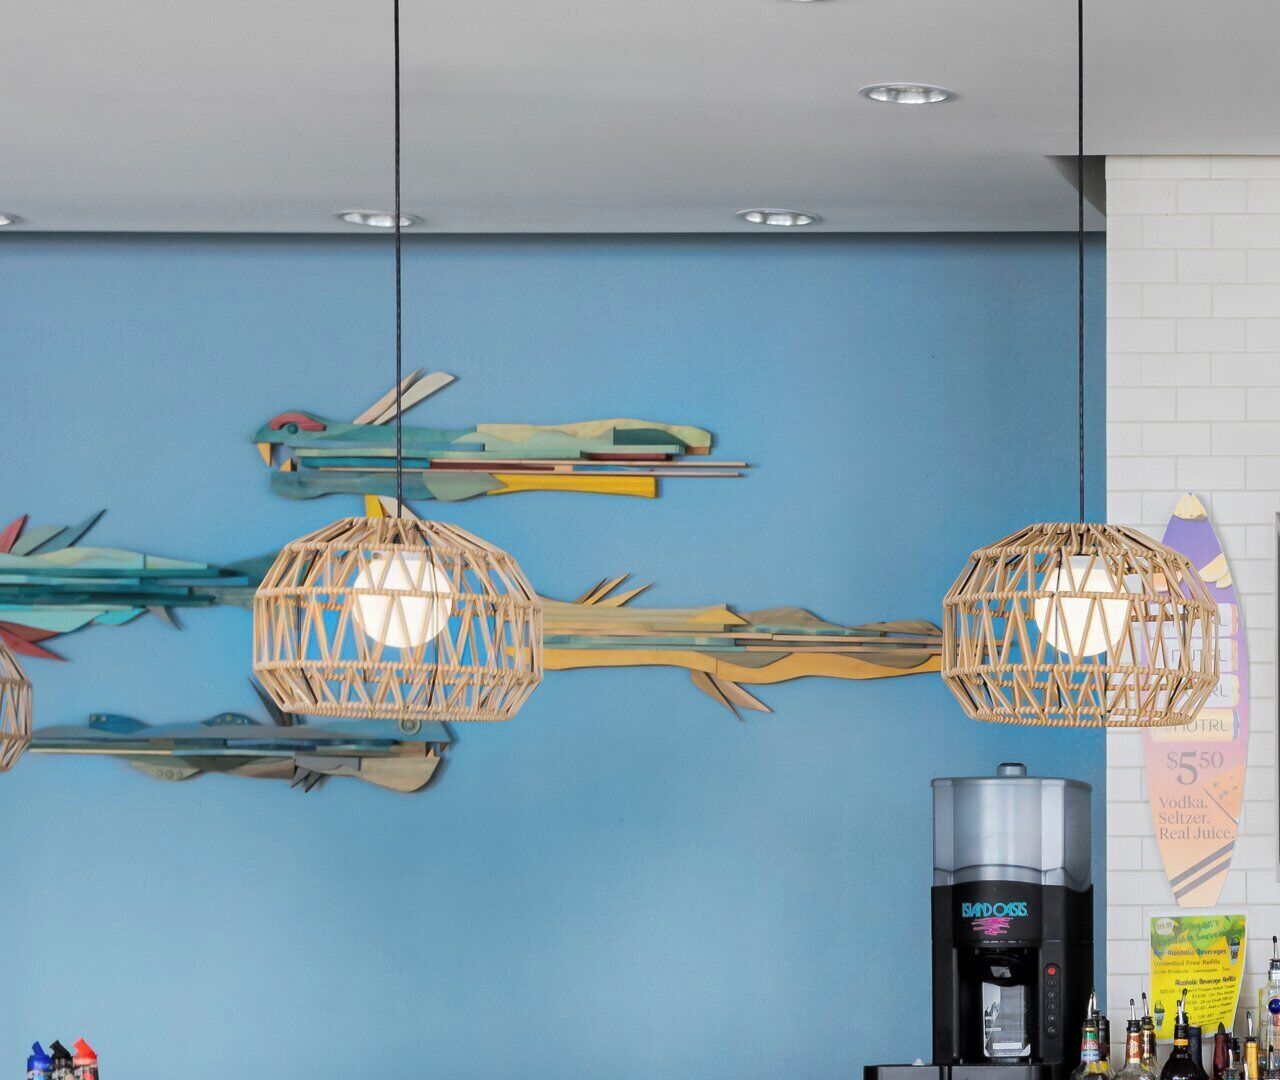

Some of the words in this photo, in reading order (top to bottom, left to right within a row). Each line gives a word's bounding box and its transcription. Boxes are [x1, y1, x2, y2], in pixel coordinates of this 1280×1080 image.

[1159, 796, 1207, 809] Vodka.
[1159, 811, 1210, 824] Seltzer.
[1159, 827, 1190, 840] Real
[1193, 827, 1234, 840] Juice.
[962, 902, 992, 917] ISLAND
[993, 902, 1028, 917] OASIS
